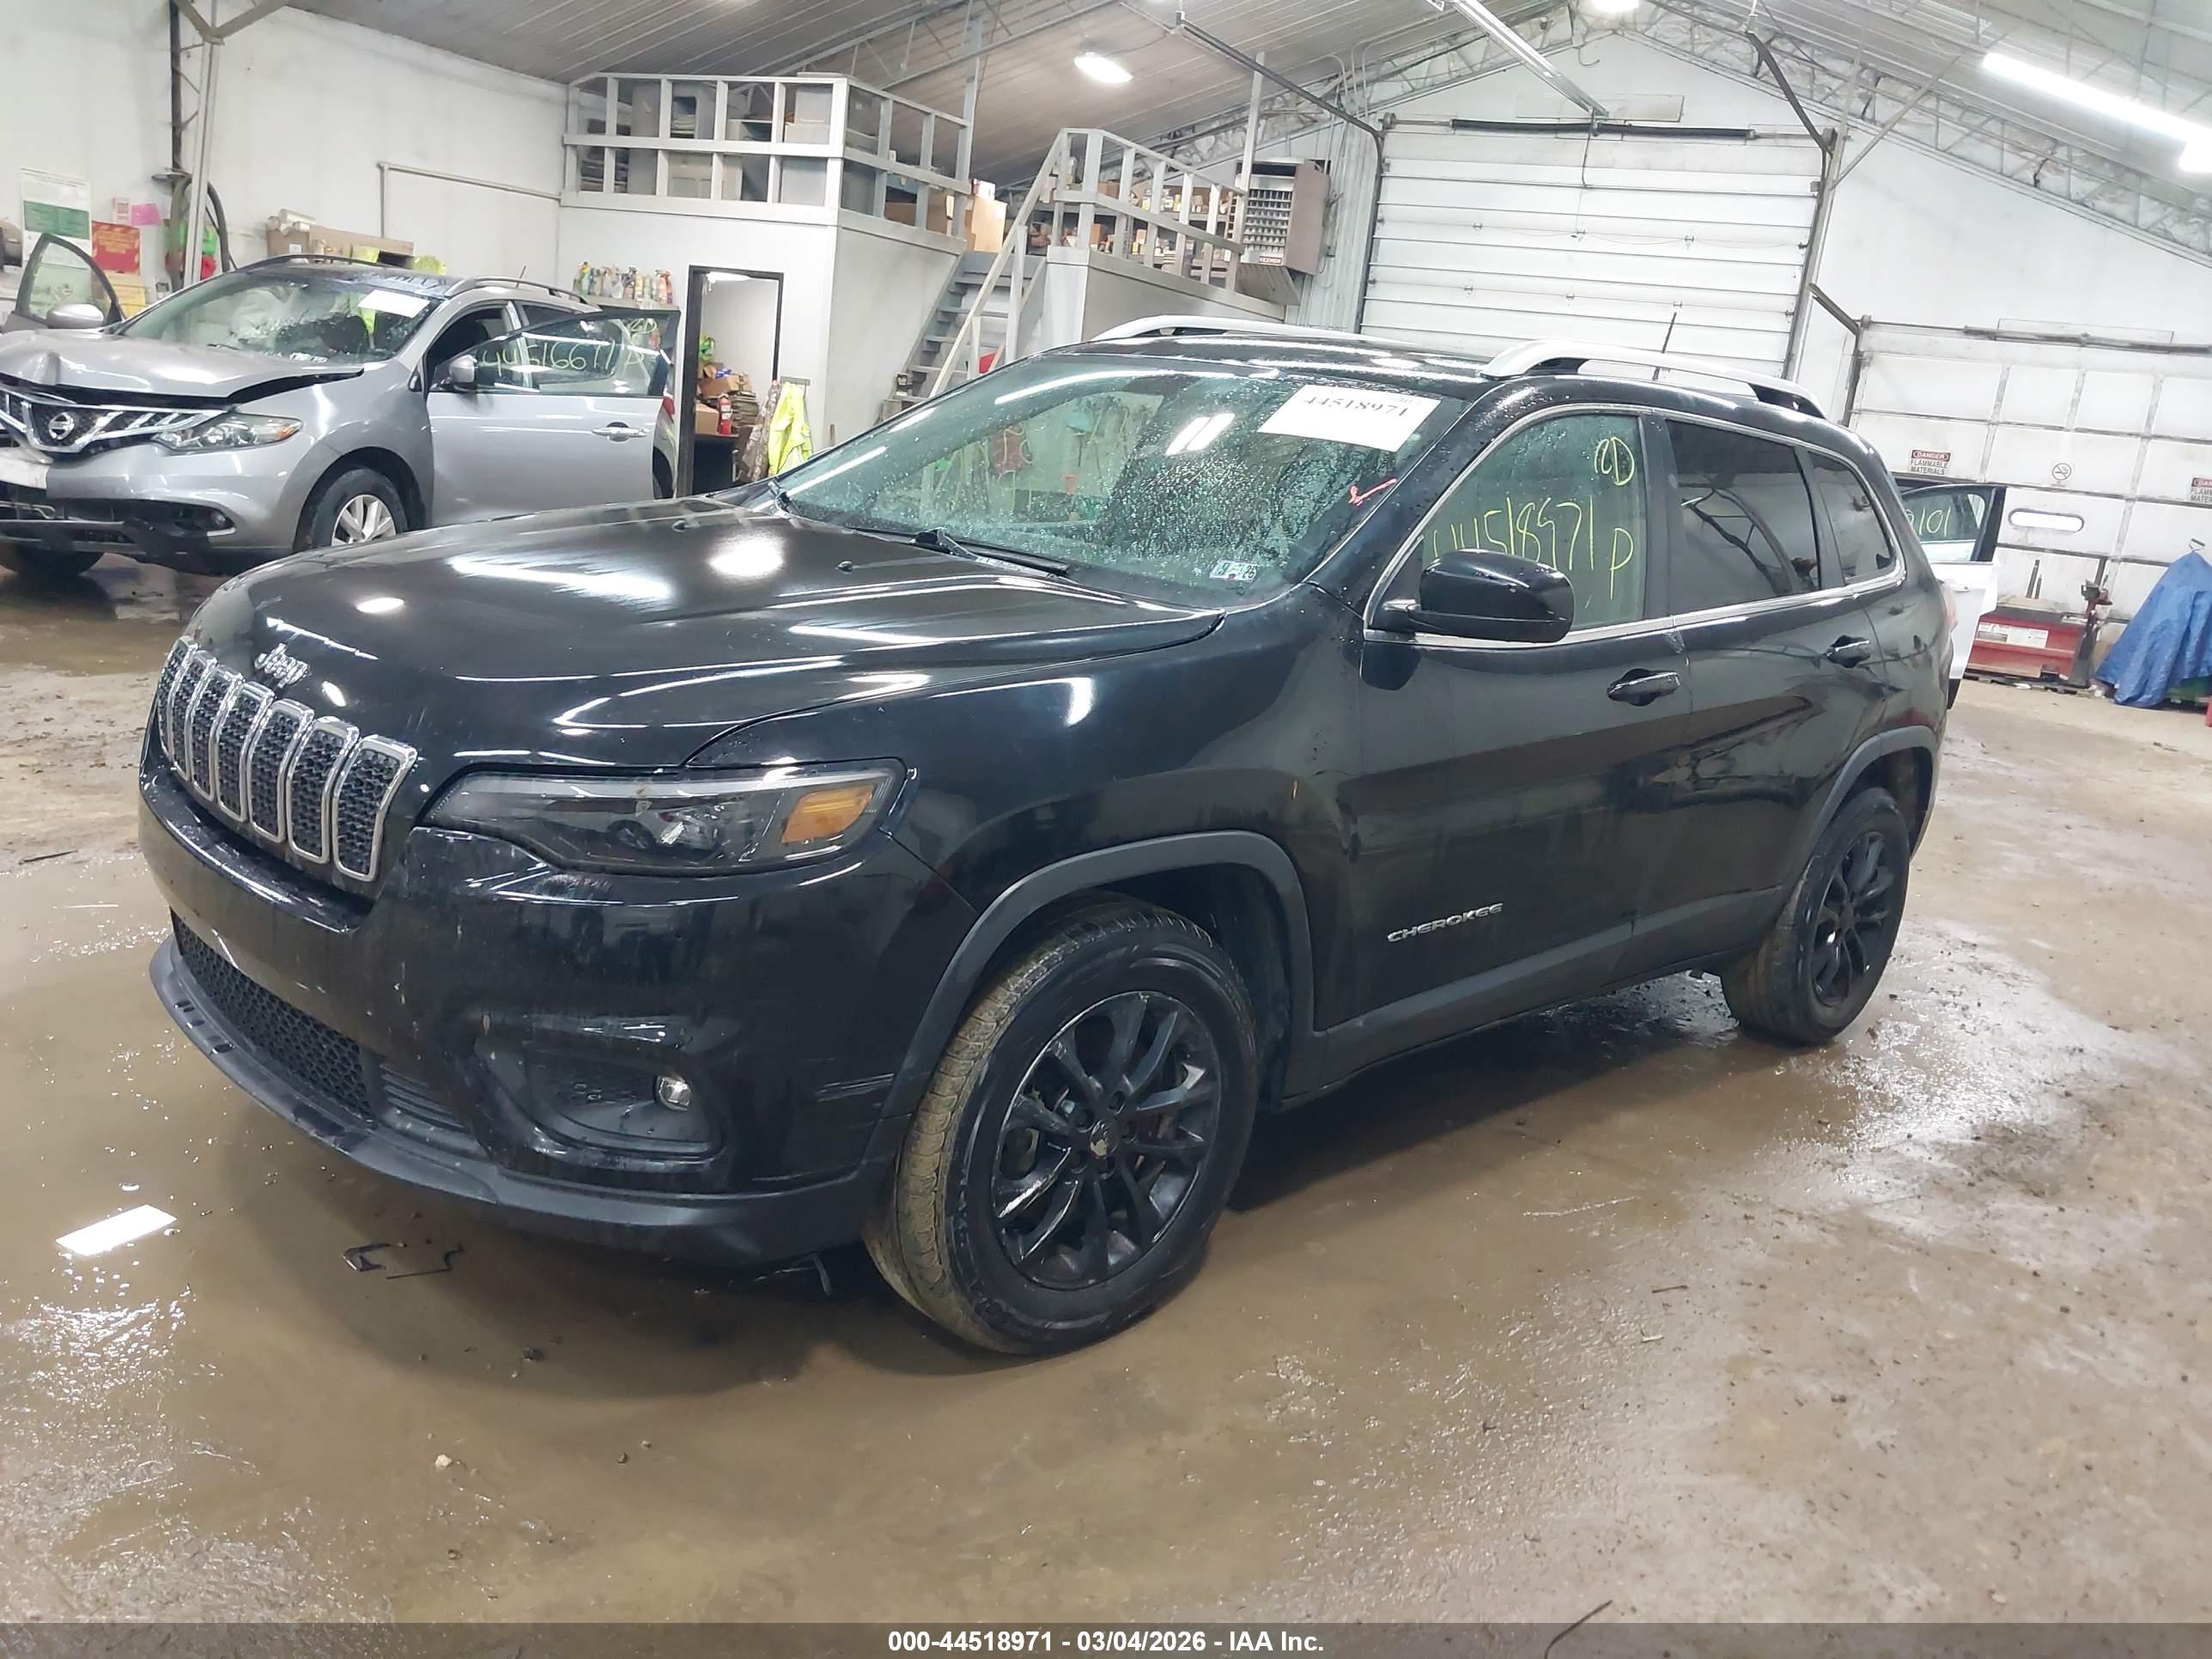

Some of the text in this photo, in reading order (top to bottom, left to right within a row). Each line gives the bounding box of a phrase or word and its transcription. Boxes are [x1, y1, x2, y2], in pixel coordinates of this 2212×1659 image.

[1303, 396, 1409, 416] 44518971
[1911, 459, 1948, 469] FLAMMABLE
[1911, 465, 1945, 475] MATERIALS
[253, 642, 309, 689] Jeep
[1387, 902, 1504, 942] CHEROKEE
